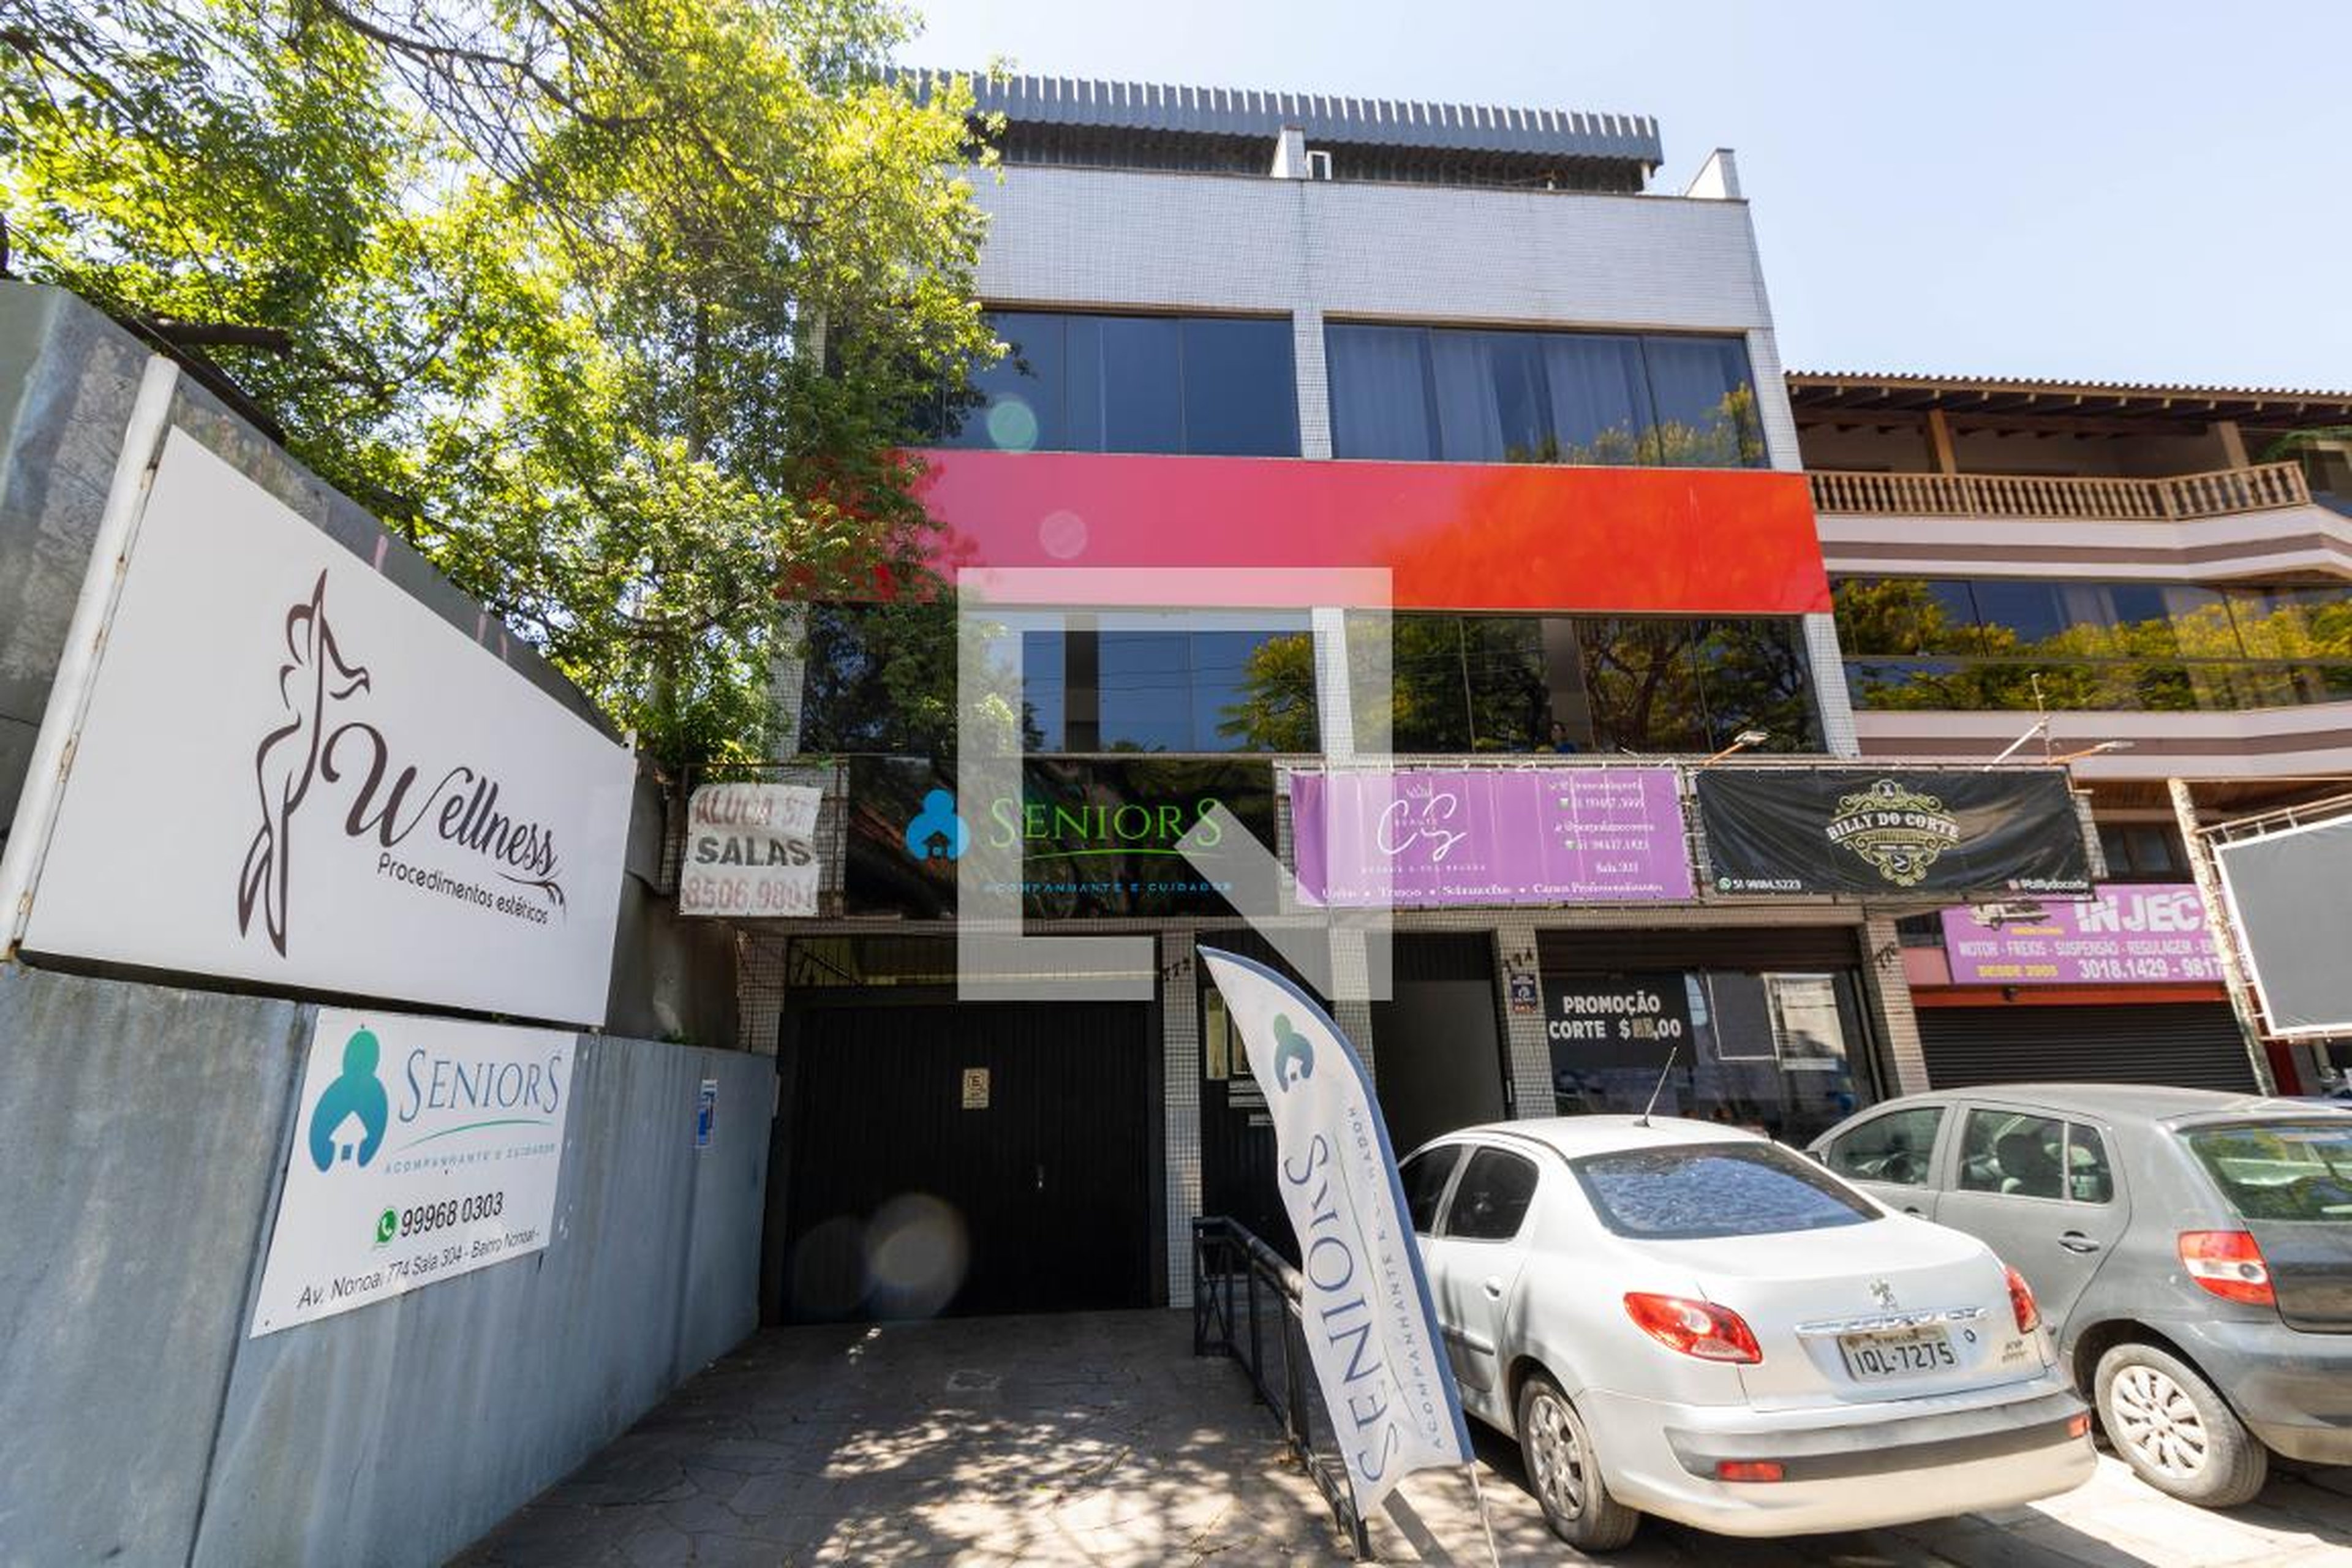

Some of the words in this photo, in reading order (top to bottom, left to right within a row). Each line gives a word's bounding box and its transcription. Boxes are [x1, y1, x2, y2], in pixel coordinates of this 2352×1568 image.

[320, 722, 558, 876] Wellness
[990, 797, 1223, 849] SENIORS
[1825, 813, 1873, 840] BILLY
[1877, 812, 1901, 826] DO
[1904, 813, 1960, 839] CORTE
[695, 836, 812, 866] SALAS
[377, 852, 493, 908] Procedimentos
[497, 896, 549, 924] estéticos
[2074, 892, 2212, 932] INJEC
[2078, 958, 2169, 979] 3018.1429
[1562, 989, 1661, 1016] PROMOÇÃO
[1548, 1020, 1607, 1039] CORTE
[398, 1048, 563, 1123] SENIORS
[401, 1199, 458, 1237] 99968
[461, 1191, 504, 1223] 0303
[296, 1286, 324, 1310] Av.
[412, 1254, 439, 1276] Sala
[440, 1245, 463, 1267] 304
